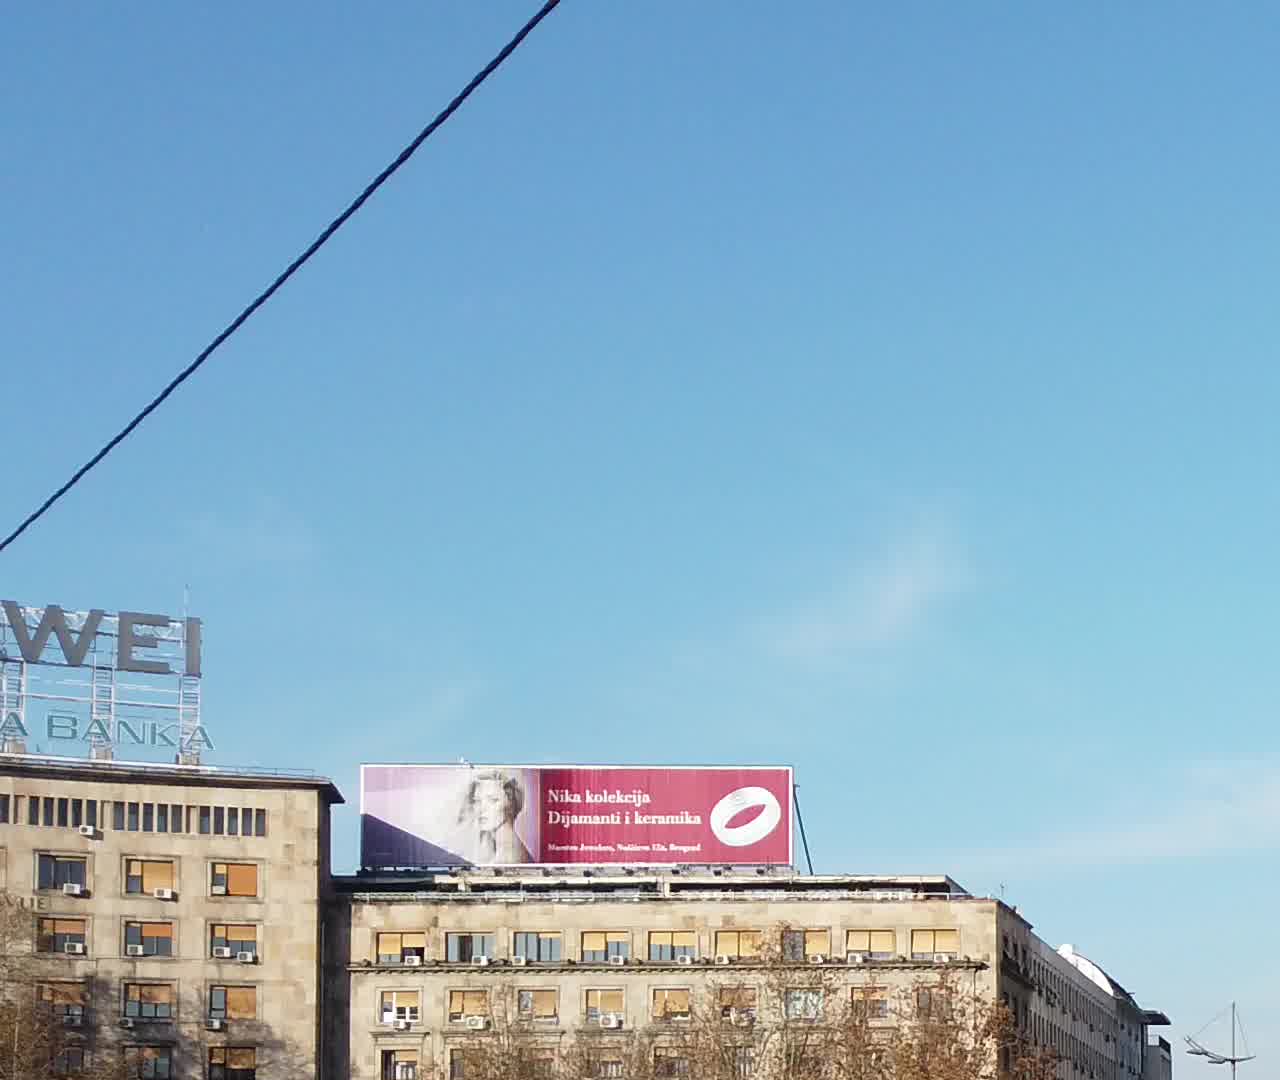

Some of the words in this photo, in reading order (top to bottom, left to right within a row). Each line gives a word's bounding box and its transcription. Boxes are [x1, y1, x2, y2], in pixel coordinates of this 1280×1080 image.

[0, 600, 201, 674] WEI
[47, 714, 216, 750] BANKA
[548, 789, 581, 803] Nika
[585, 789, 651, 807] kolekcija
[548, 811, 621, 828] Dijamanti
[625, 811, 631, 825] i
[634, 811, 702, 825] keramika
